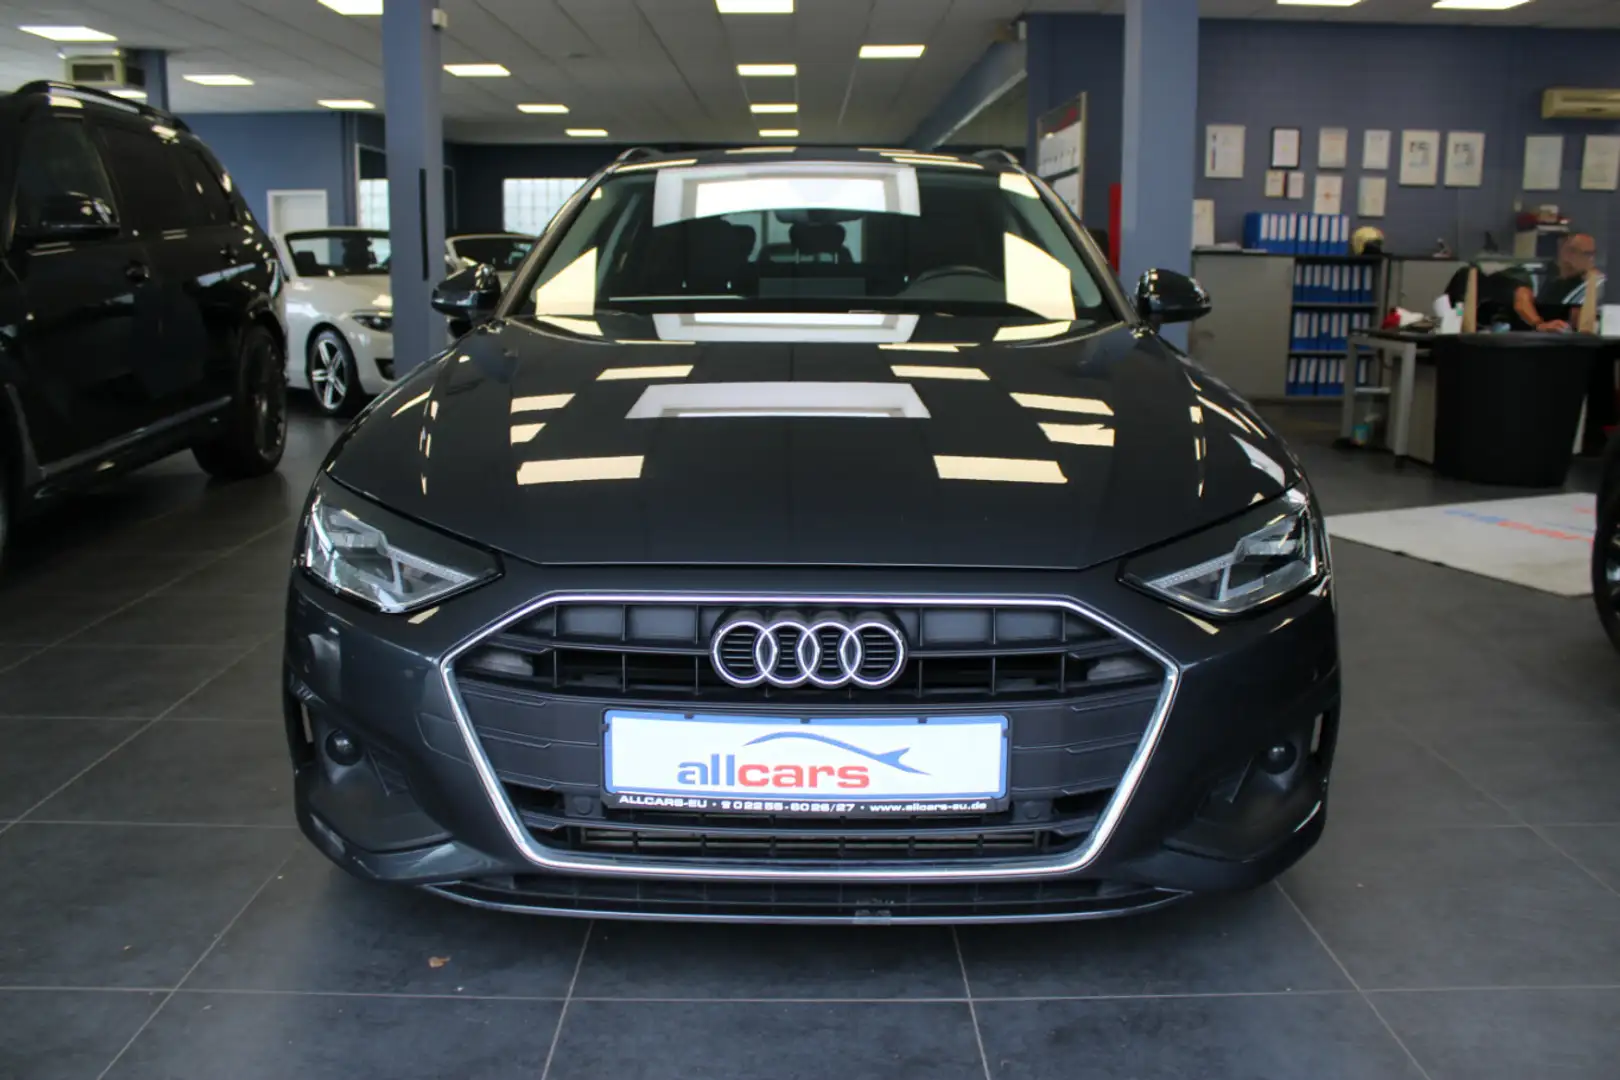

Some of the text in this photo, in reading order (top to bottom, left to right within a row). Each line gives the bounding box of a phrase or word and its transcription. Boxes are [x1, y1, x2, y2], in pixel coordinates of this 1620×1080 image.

[677, 753, 870, 789] allcars
[619, 795, 708, 809] ALLCARS-EU
[869, 801, 987, 812] www.allcars-eu.de
